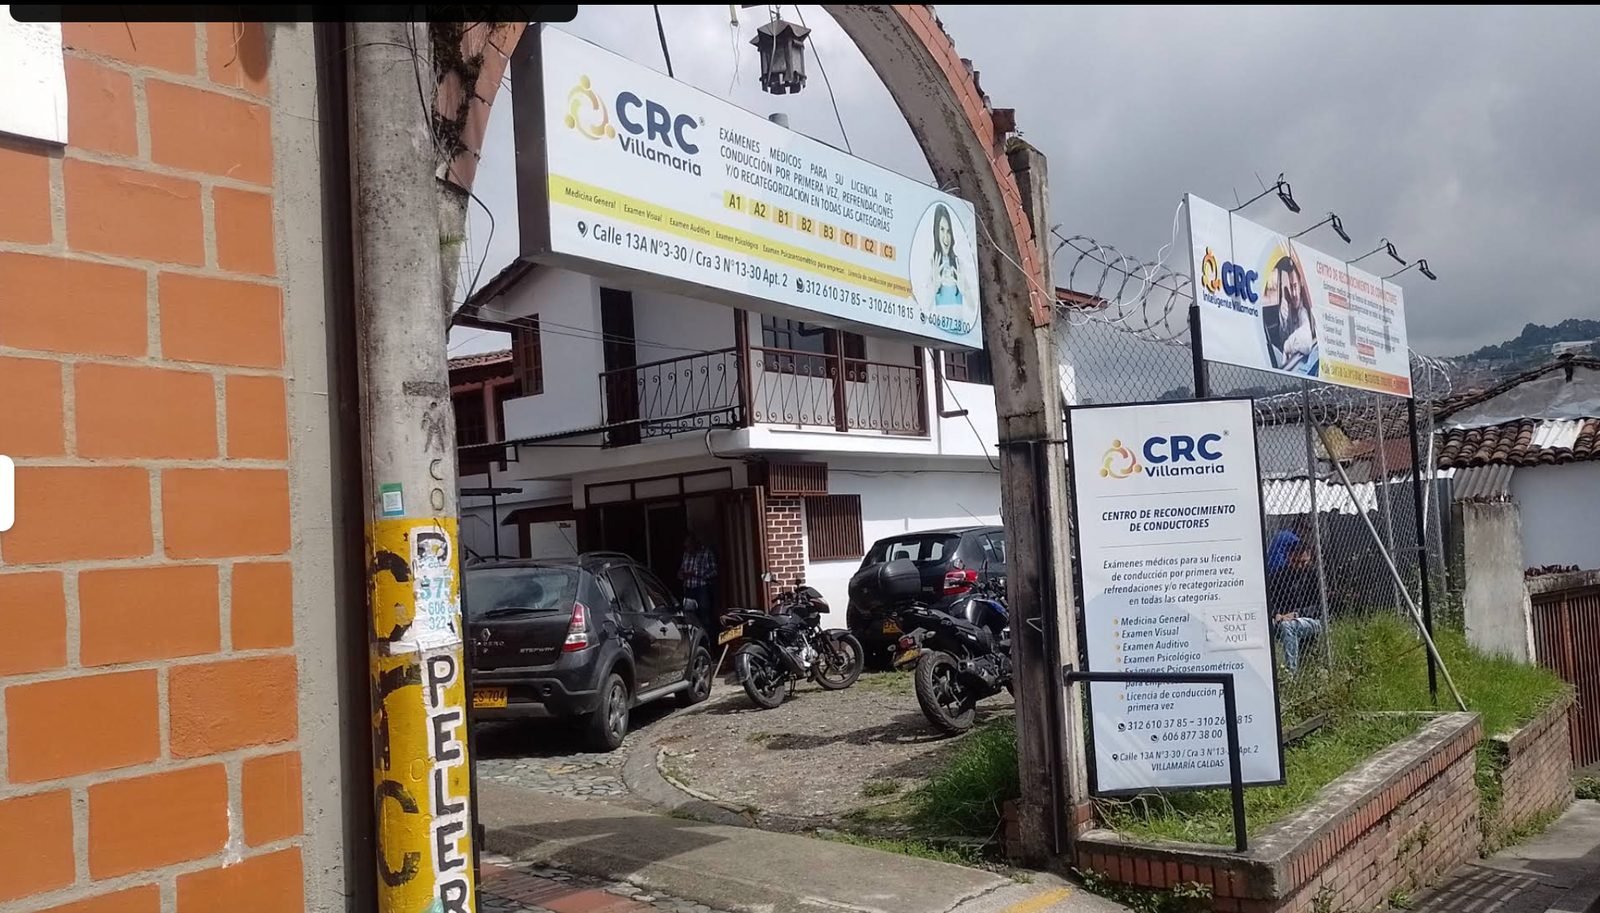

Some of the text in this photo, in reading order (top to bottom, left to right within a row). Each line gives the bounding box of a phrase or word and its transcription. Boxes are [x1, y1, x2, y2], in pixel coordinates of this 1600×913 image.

[616, 91, 699, 155] CRC
[618, 133, 701, 176] Villamaria
[719, 127, 892, 205] EXÁMENES MÉDICOS PARA SU LICENCIA DE
[720, 145, 772, 175] CONDUCCIÓN
[775, 165, 791, 181] POR
[793, 172, 824, 194] PRIMERA
[842, 191, 894, 219] REFRENDACIONES
[565, 187, 617, 209] Medicina General
[725, 163, 890, 233] Y/O RECATEGORIZACIÓN EN TODAS LAS CATEGORÍAS
[624, 203, 663, 222] Examen Visual
[669, 217, 711, 237] Examen Auditivo
[729, 194, 893, 259] A1 A2 B1 B2 B3 C1 C2 C3
[593, 223, 622, 246] Calle
[625, 232, 647, 253] 13A
[689, 248, 694, 264] /
[696, 251, 712, 268] Cra
[714, 255, 721, 270] 3
[762, 268, 781, 287] Apt.
[782, 273, 788, 287] 2
[1221, 260, 1259, 304] CRC
[806, 279, 821, 296] 312
[822, 284, 838, 301] 610
[839, 288, 850, 303] 37
[850, 292, 860, 306] 85
[1142, 433, 1223, 464] CRC
[1145, 464, 1225, 478] Villamaria
[1102, 504, 1236, 521] CENTRO DE RECONOCIMIENTO
[1129, 518, 1209, 532] DE CONDUCTORES
[1103, 553, 1242, 570] Exámenes médicos para su licencia
[1111, 567, 1235, 582] de conducción por primera vez,
[1104, 578, 1245, 595] refrendaciones y/o recategorización
[1129, 592, 1221, 606] en todas las categorías.
[1121, 613, 1190, 626] Medicina General
[1211, 612, 1257, 623] VENTA DE
[1121, 626, 1179, 638] Examen Visual
[1223, 623, 1247, 633] SOAT
[1122, 640, 1190, 652] Examen Auditivo
[1124, 651, 1201, 664] Examen Psicológico
[1166, 661, 1245, 674] Psicosensométricos
[1126, 692, 1158, 701] Licencia
[1159, 690, 1170, 699] de
[1171, 688, 1217, 698] conducción
[1127, 702, 1175, 714] primera vez
[1127, 721, 1144, 731] 312
[1145, 720, 1162, 729] 610
[1164, 719, 1175, 728] 37
[1176, 718, 1188, 727] 85
[1214, 716, 1226, 725] 26
[1162, 729, 1223, 742] 606 877 38 00
[1119, 752, 1138, 762] Calle
[1140, 751, 1154, 760] 13A
[1186, 748, 1199, 758] Cra
[1200, 748, 1205, 757] 3
[1253, 745, 1259, 753] 2
[1151, 759, 1225, 772] VILLAMARÍA CALDAS
